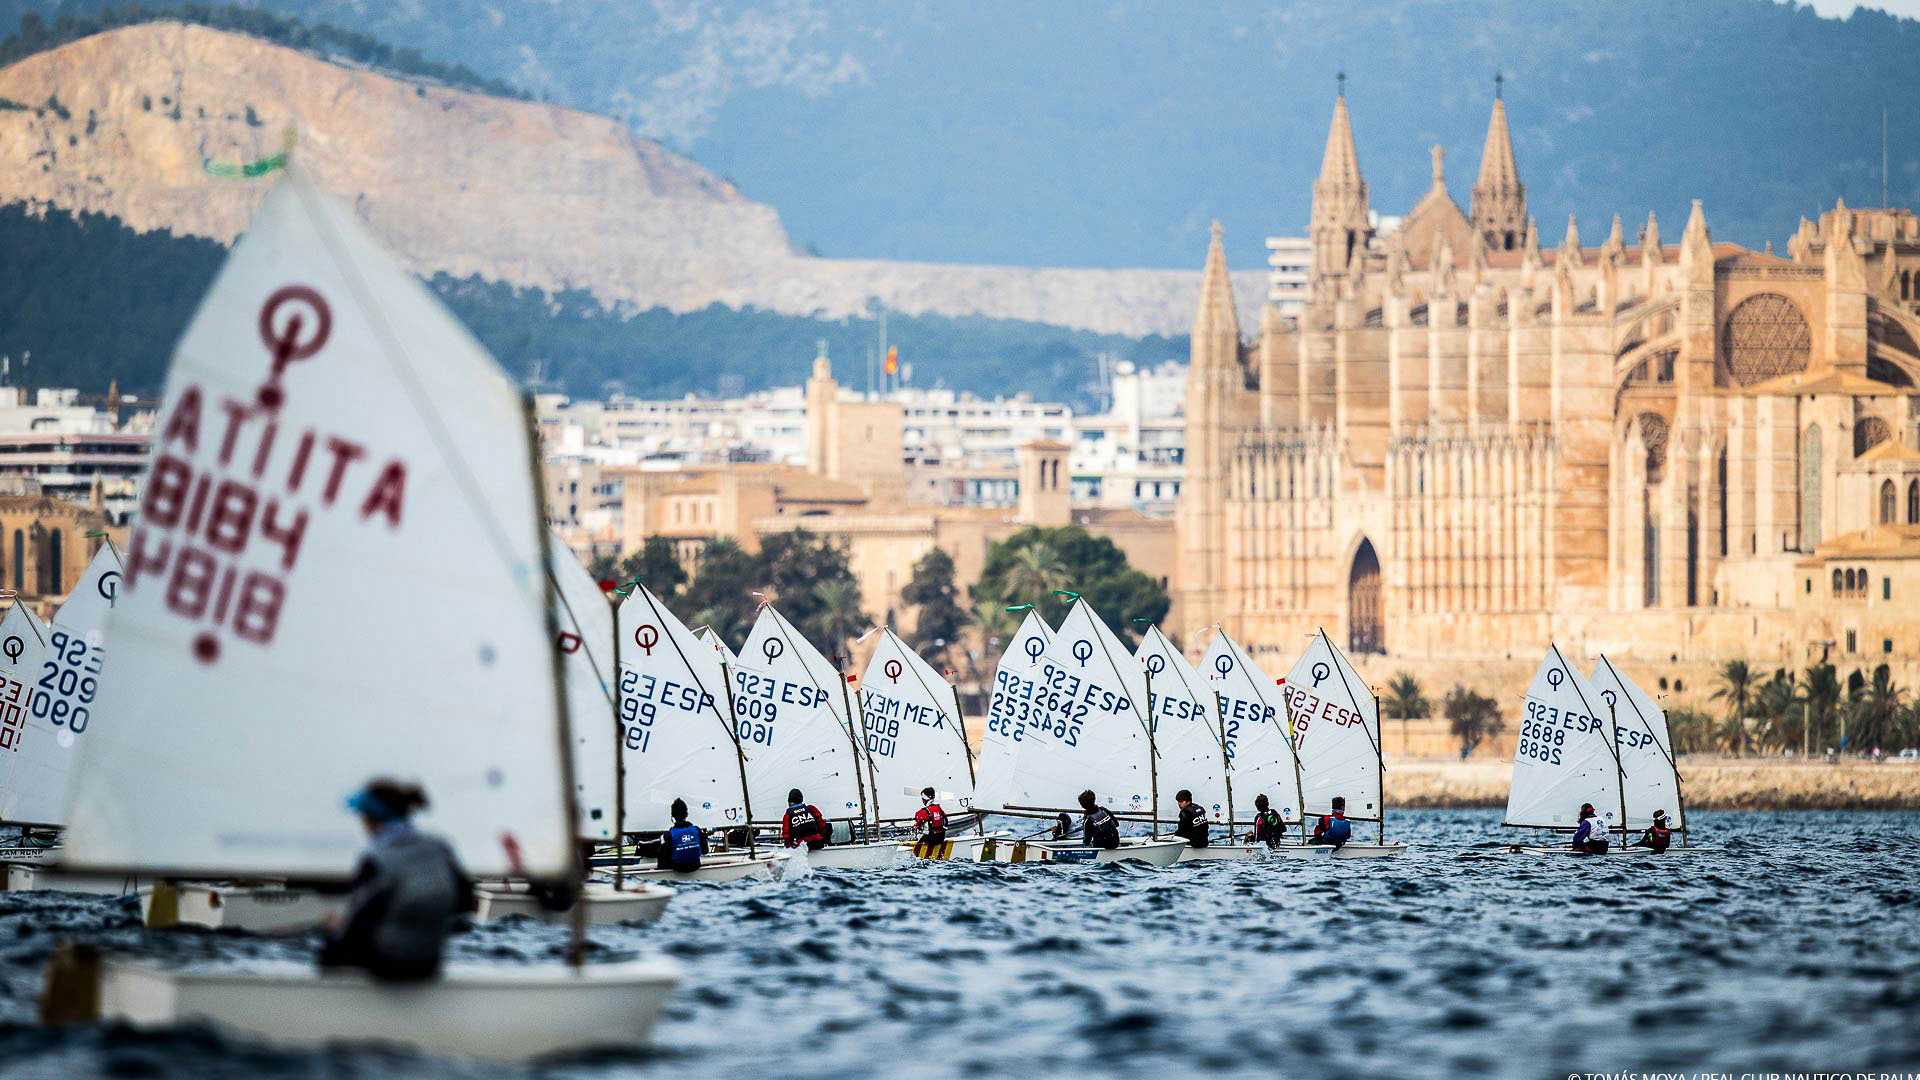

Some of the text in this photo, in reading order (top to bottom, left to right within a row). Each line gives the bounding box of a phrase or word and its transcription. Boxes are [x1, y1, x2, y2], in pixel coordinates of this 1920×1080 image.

[286, 428, 408, 527] ITA
[143, 453, 309, 570] 8184
[38, 661, 98, 704] 209
[781, 682, 830, 709] ESP
[660, 681, 715, 715] ESP
[992, 692, 1030, 721] 253
[1034, 686, 1089, 726] 2642
[1083, 683, 1131, 716] ESP
[1162, 696, 1206, 722] ESP
[1232, 699, 1276, 724] ESP
[621, 697, 657, 727] 99
[865, 712, 900, 738] 008
[903, 702, 945, 730] MEX
[1321, 702, 1362, 729] ESP
[1563, 711, 1603, 734] ESP
[1521, 719, 1565, 746] 2688
[1614, 725, 1654, 750] ESP
[791, 812, 815, 825] CNA
